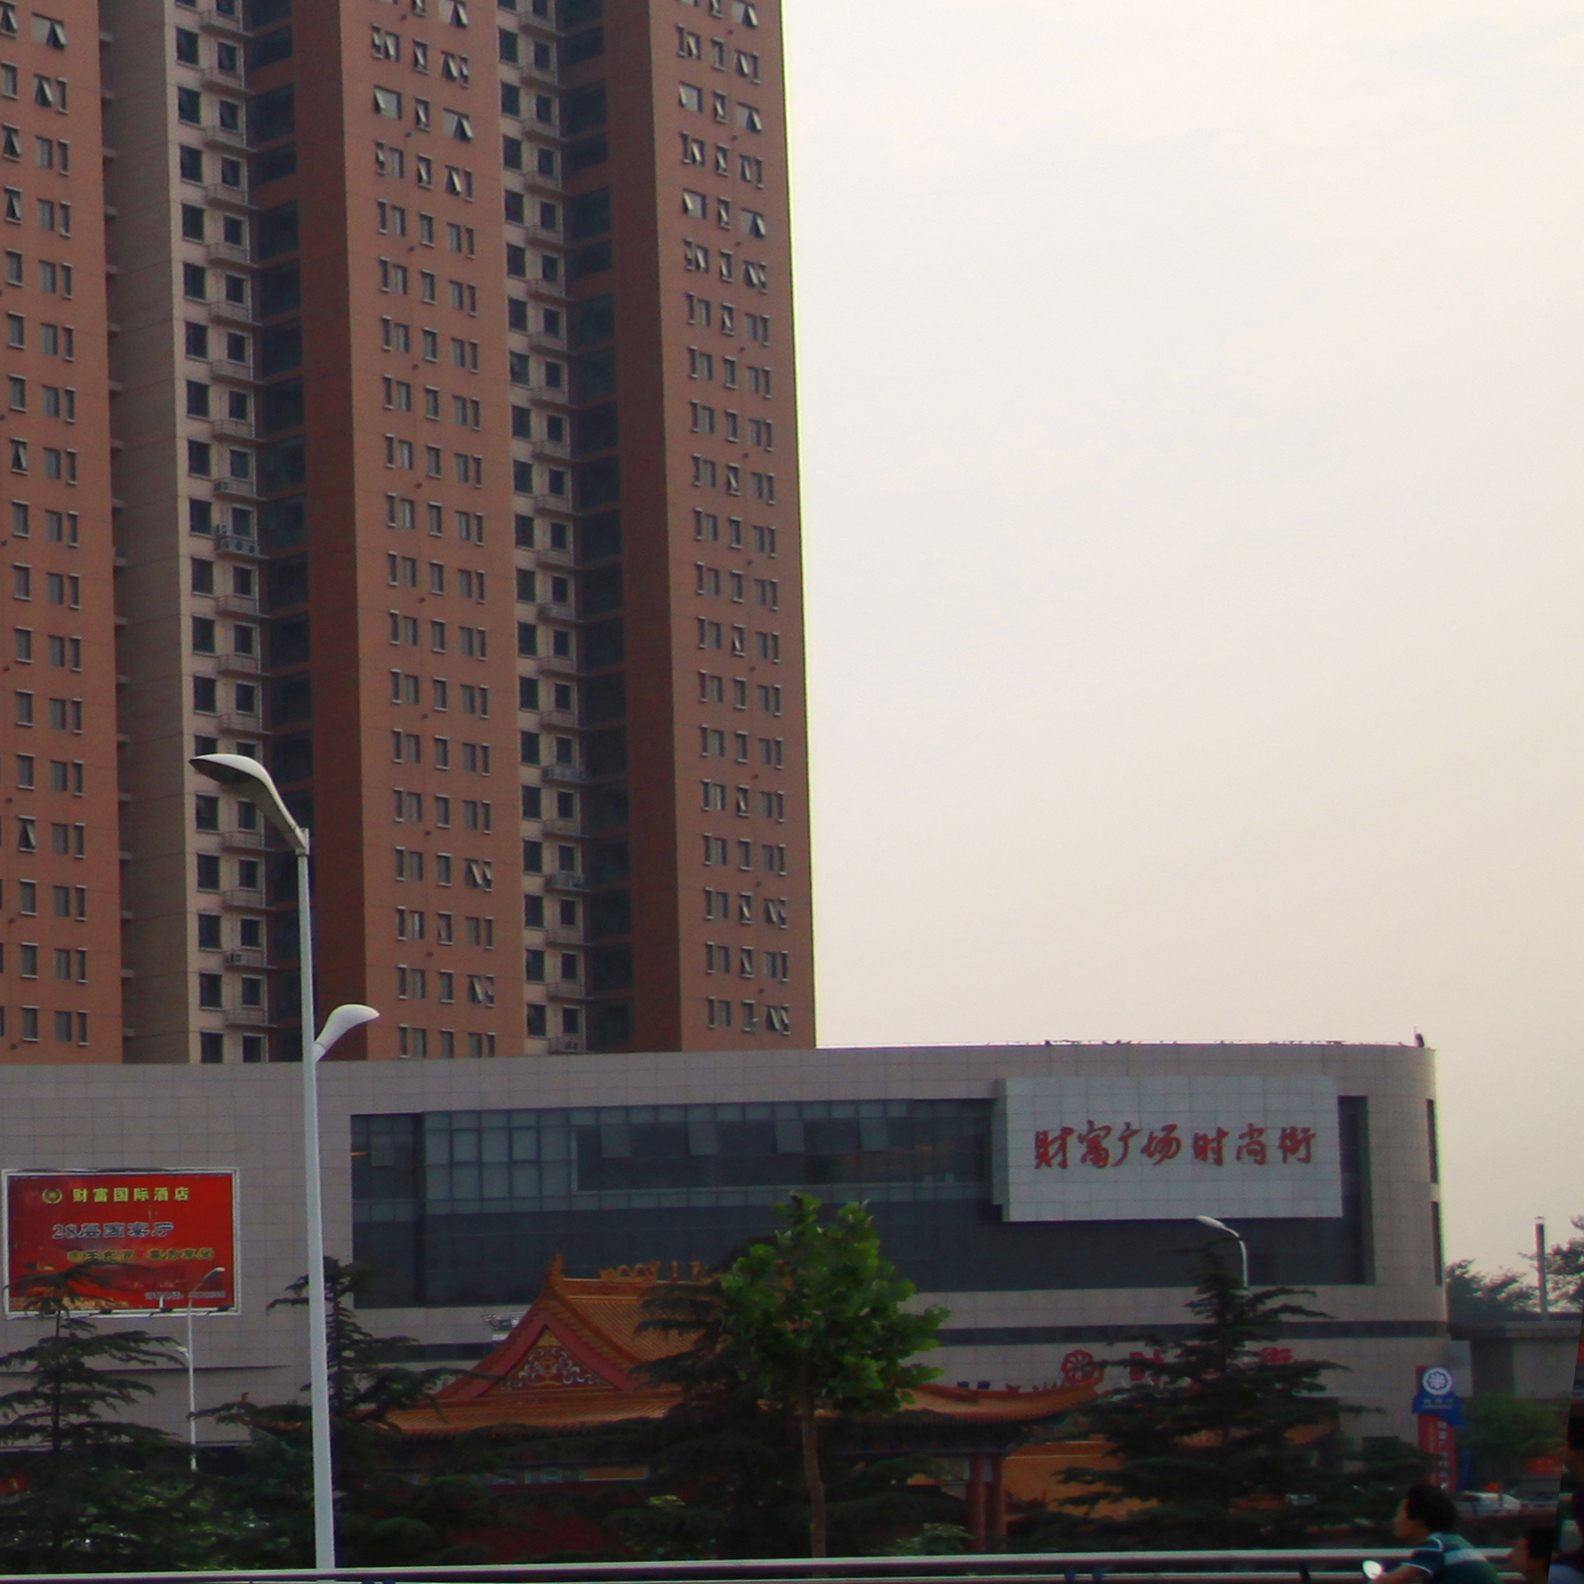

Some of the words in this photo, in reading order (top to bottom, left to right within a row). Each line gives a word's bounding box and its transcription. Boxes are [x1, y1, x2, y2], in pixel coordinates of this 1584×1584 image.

[72, 1187, 190, 1203] 财富国际酒店
